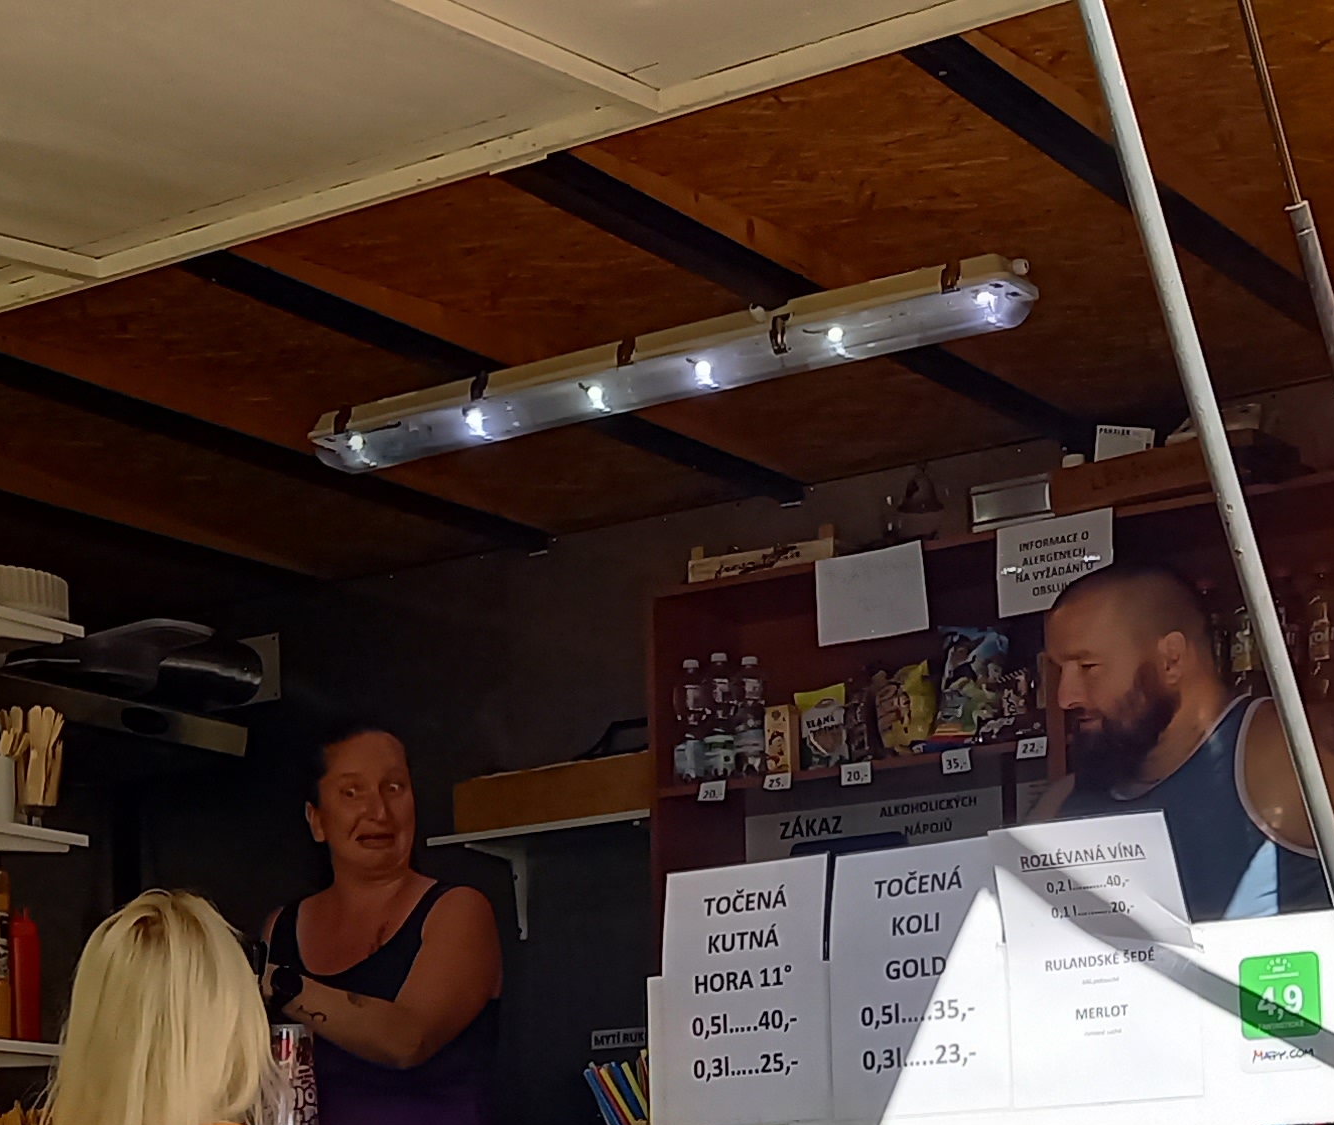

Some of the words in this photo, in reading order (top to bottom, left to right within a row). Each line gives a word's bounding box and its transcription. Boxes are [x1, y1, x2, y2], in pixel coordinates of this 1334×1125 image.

[1019, 533, 1078, 552] INFORMACE
[1081, 531, 1089, 540] O
[1014, 573, 1030, 583] NA
[1032, 582, 1067, 596] OBSLU
[846, 770, 868, 781] 20,-
[946, 758, 967, 769] 35,-
[780, 815, 842, 840] ZÁKAZ
[880, 796, 977, 818] ALKOHOLICKÝCH
[904, 820, 953, 836] NÁPOJŮ
[1020, 845, 1105, 870] ROZLÉVANÁ
[1107, 842, 1146, 859] VÍNA
[874, 864, 963, 899] TOČENÁ
[703, 885, 788, 918] TOČENÁ
[890, 911, 941, 938] KOLI
[707, 923, 779, 954] KUTNÁ
[884, 954, 947, 982] GOLD
[1045, 951, 1119, 972] RULANDSKÉ
[1123, 946, 1155, 964] ŠEDÉ
[693, 968, 754, 996] HORA
[758, 964, 793, 989] 11°
[1075, 1004, 1128, 1020] MERLOT
[1257, 984, 1304, 1020] 4,9
[594, 1031, 621, 1047] MYTÍ
[623, 1031, 644, 1044] RUK
